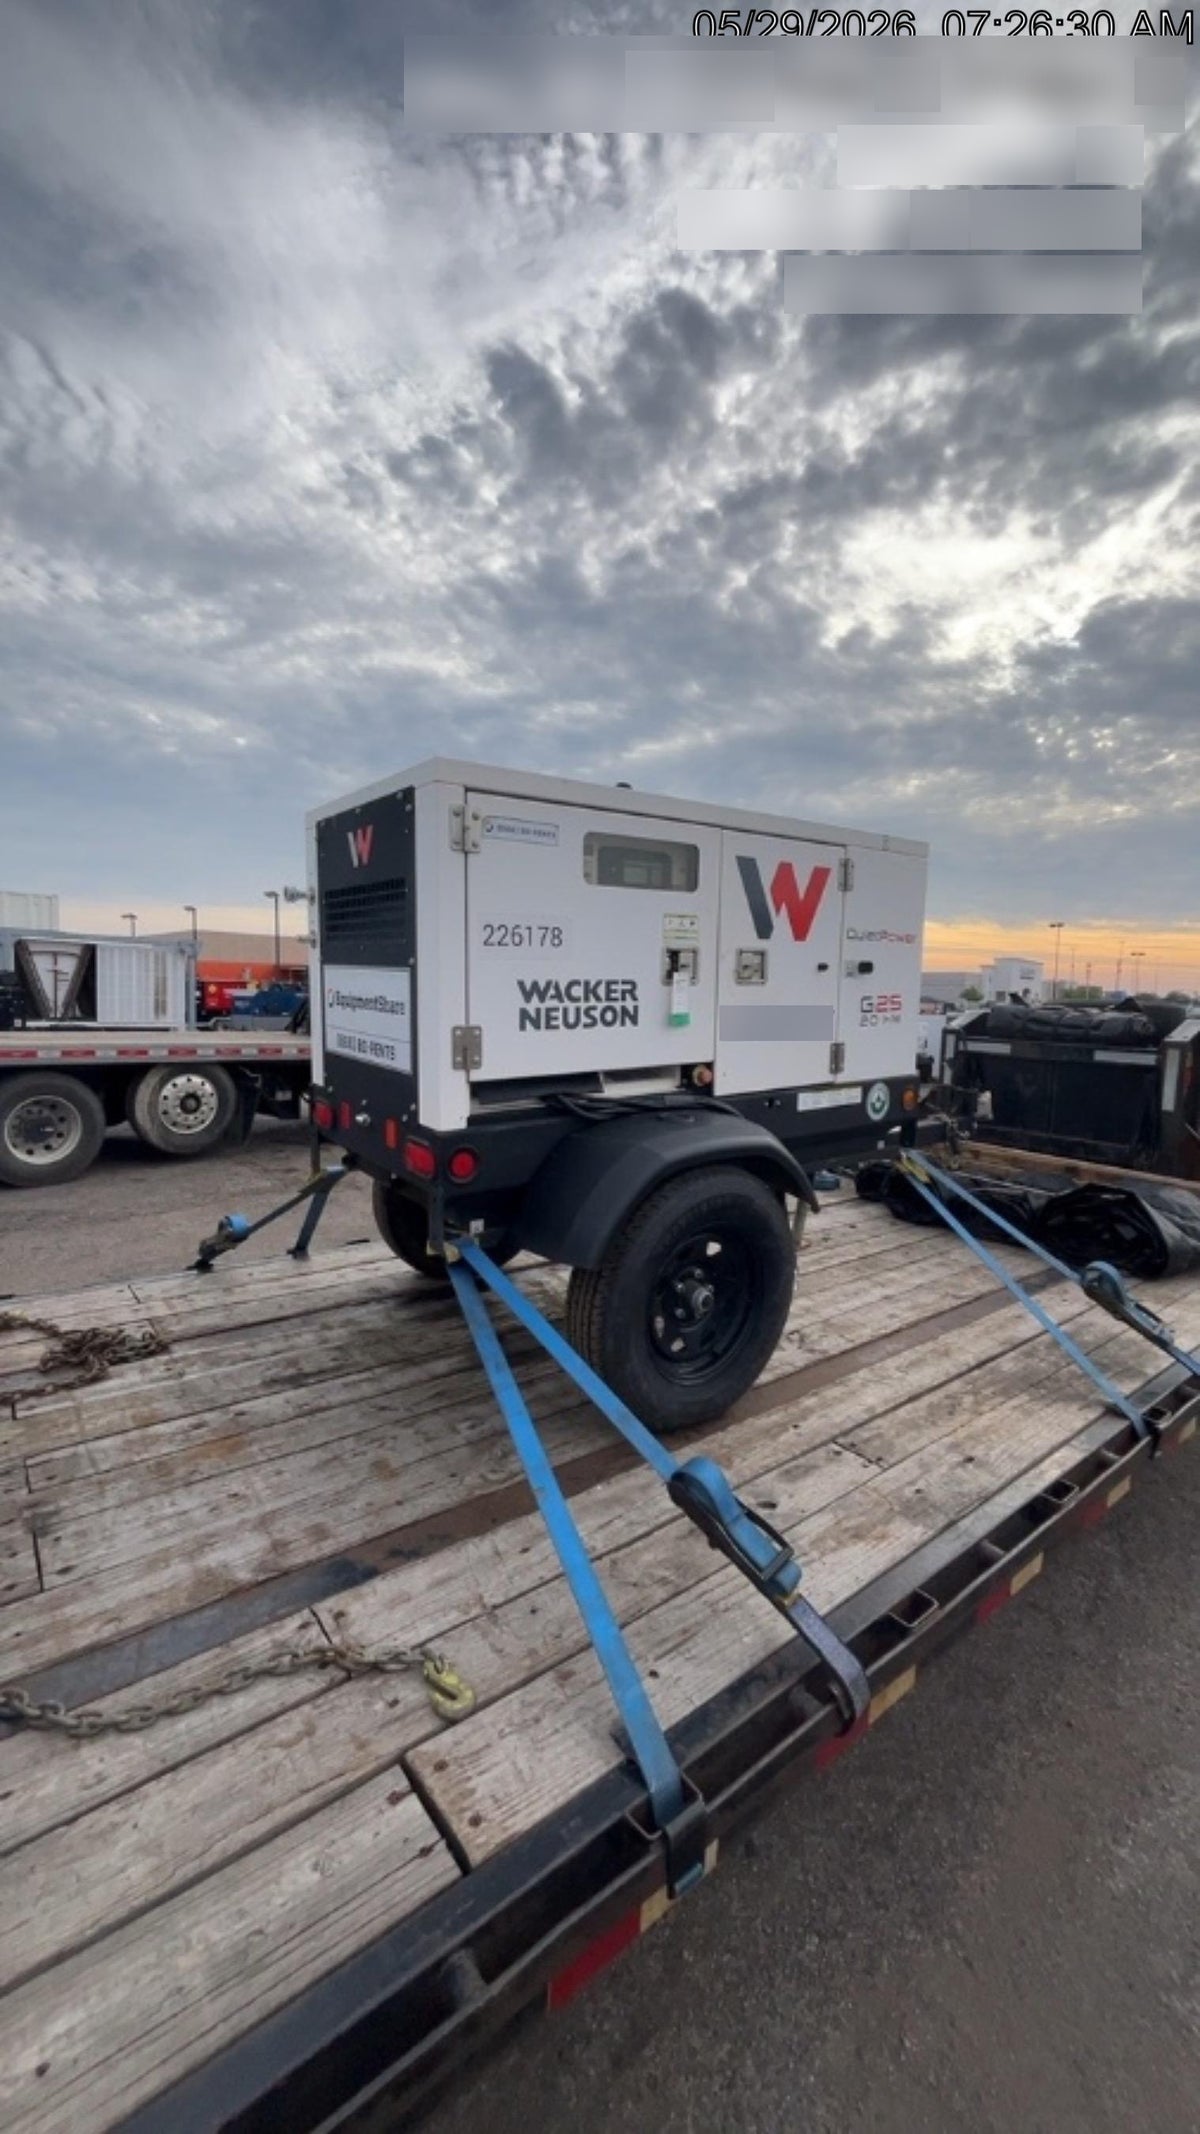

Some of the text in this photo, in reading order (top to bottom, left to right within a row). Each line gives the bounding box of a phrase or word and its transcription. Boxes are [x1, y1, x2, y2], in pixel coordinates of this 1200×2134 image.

[482, 923, 563, 948] 226178
[517, 978, 638, 1004] WACKER
[860, 994, 902, 1014] G25
[518, 1005, 639, 1032] NEUSON
